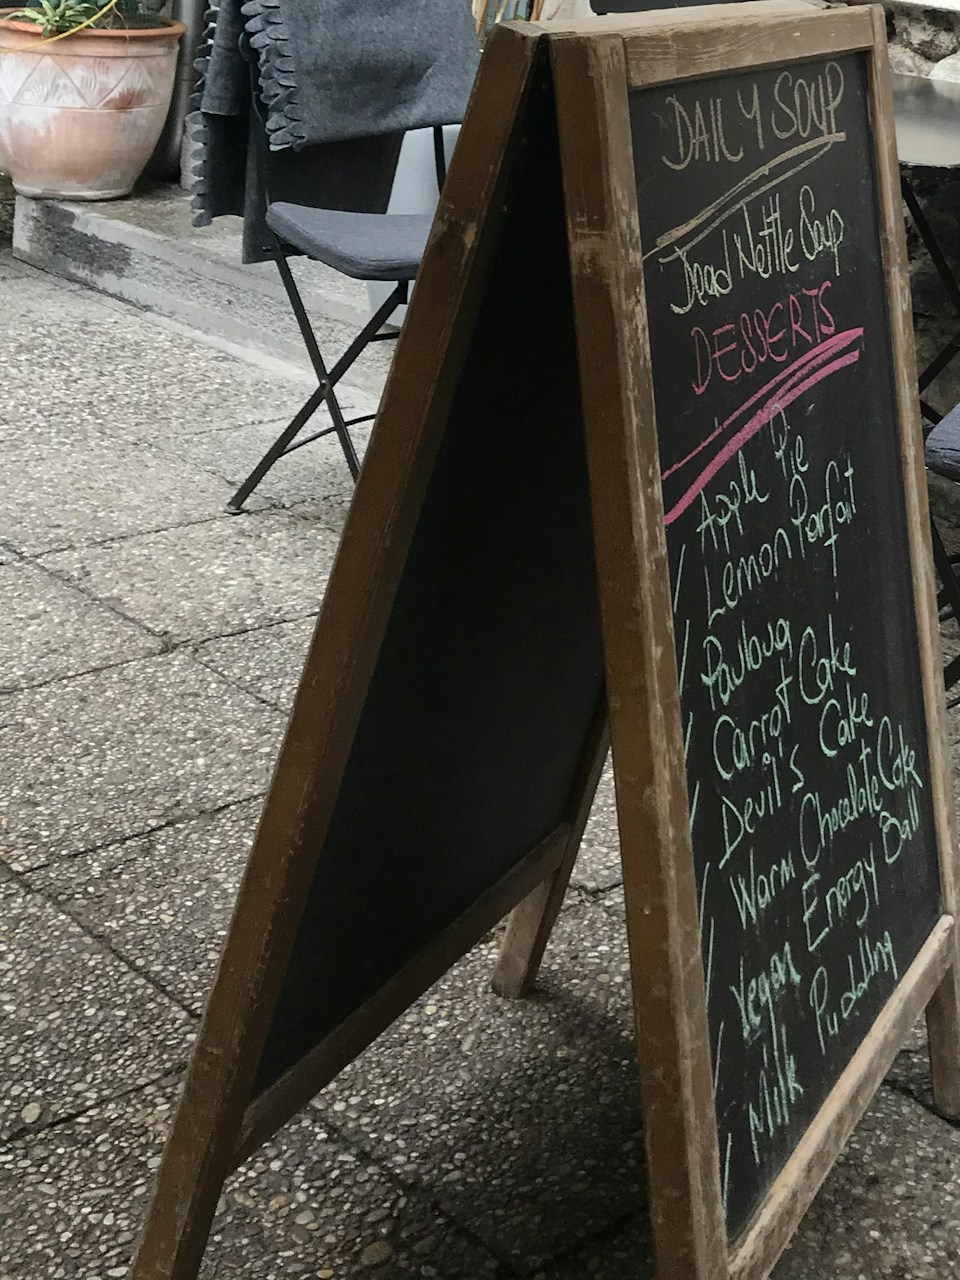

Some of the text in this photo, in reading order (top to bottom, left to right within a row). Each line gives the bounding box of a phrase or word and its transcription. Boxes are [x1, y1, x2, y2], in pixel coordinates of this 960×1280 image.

[772, 61, 844, 139] SOUP
[733, 193, 800, 279] Nettle
[799, 185, 845, 276] Soup
[691, 281, 836, 395] DESSERTS
[769, 402, 809, 481] Pie
[703, 455, 856, 628] Lemon Parfait
[713, 614, 856, 780] Carrot Cake
[819, 680, 873, 757] Cake
[729, 847, 796, 930] Warm
[877, 716, 923, 790] Cake
[801, 842, 879, 952] Energy
[879, 786, 919, 864] Ball
[749, 1024, 804, 1164] Milk
